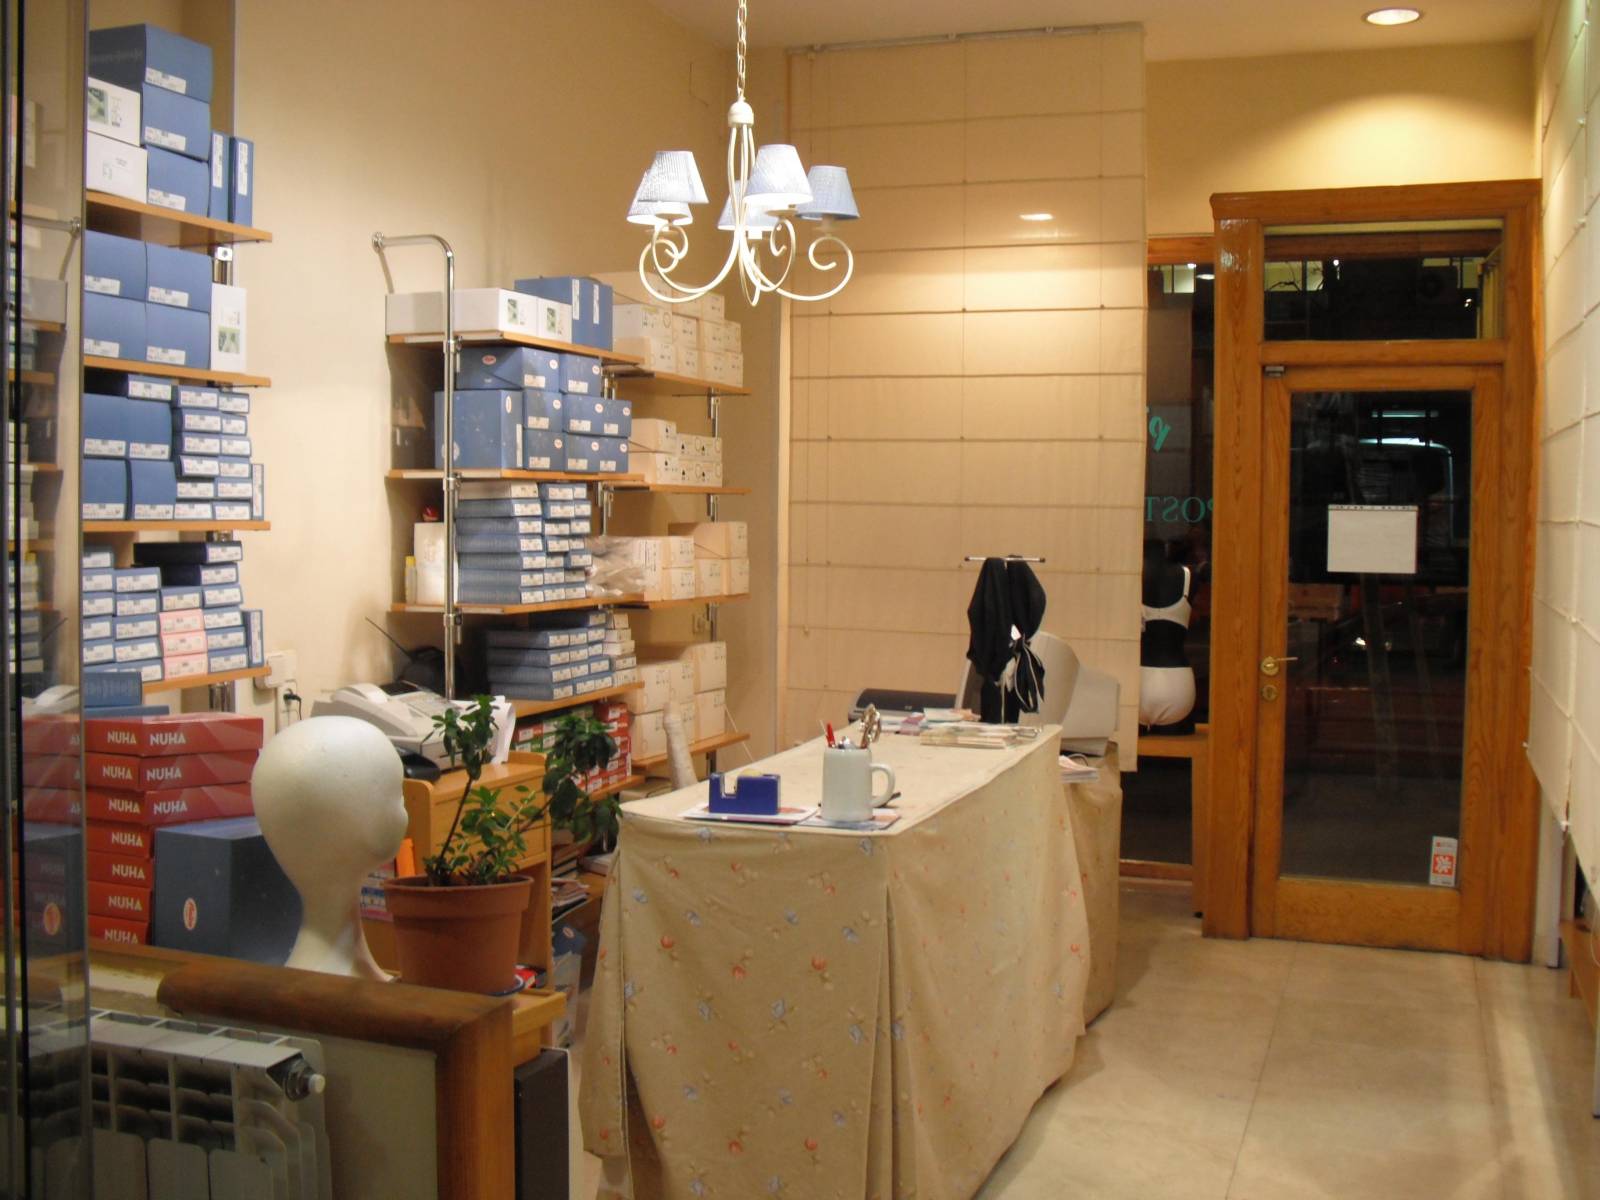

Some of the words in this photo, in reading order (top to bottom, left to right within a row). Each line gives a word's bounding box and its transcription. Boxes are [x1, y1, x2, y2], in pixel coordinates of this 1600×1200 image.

[107, 731, 137, 745] NUHA
[149, 733, 186, 746] NUHA
[102, 766, 133, 780] NUHA
[146, 767, 182, 781] NUHA
[108, 799, 140, 814] NUHA
[153, 801, 188, 815] NUHA
[111, 832, 143, 848] NUHA
[112, 864, 145, 879] NUHA
[108, 896, 143, 911] NUHA
[104, 929, 138, 944] NUHA
